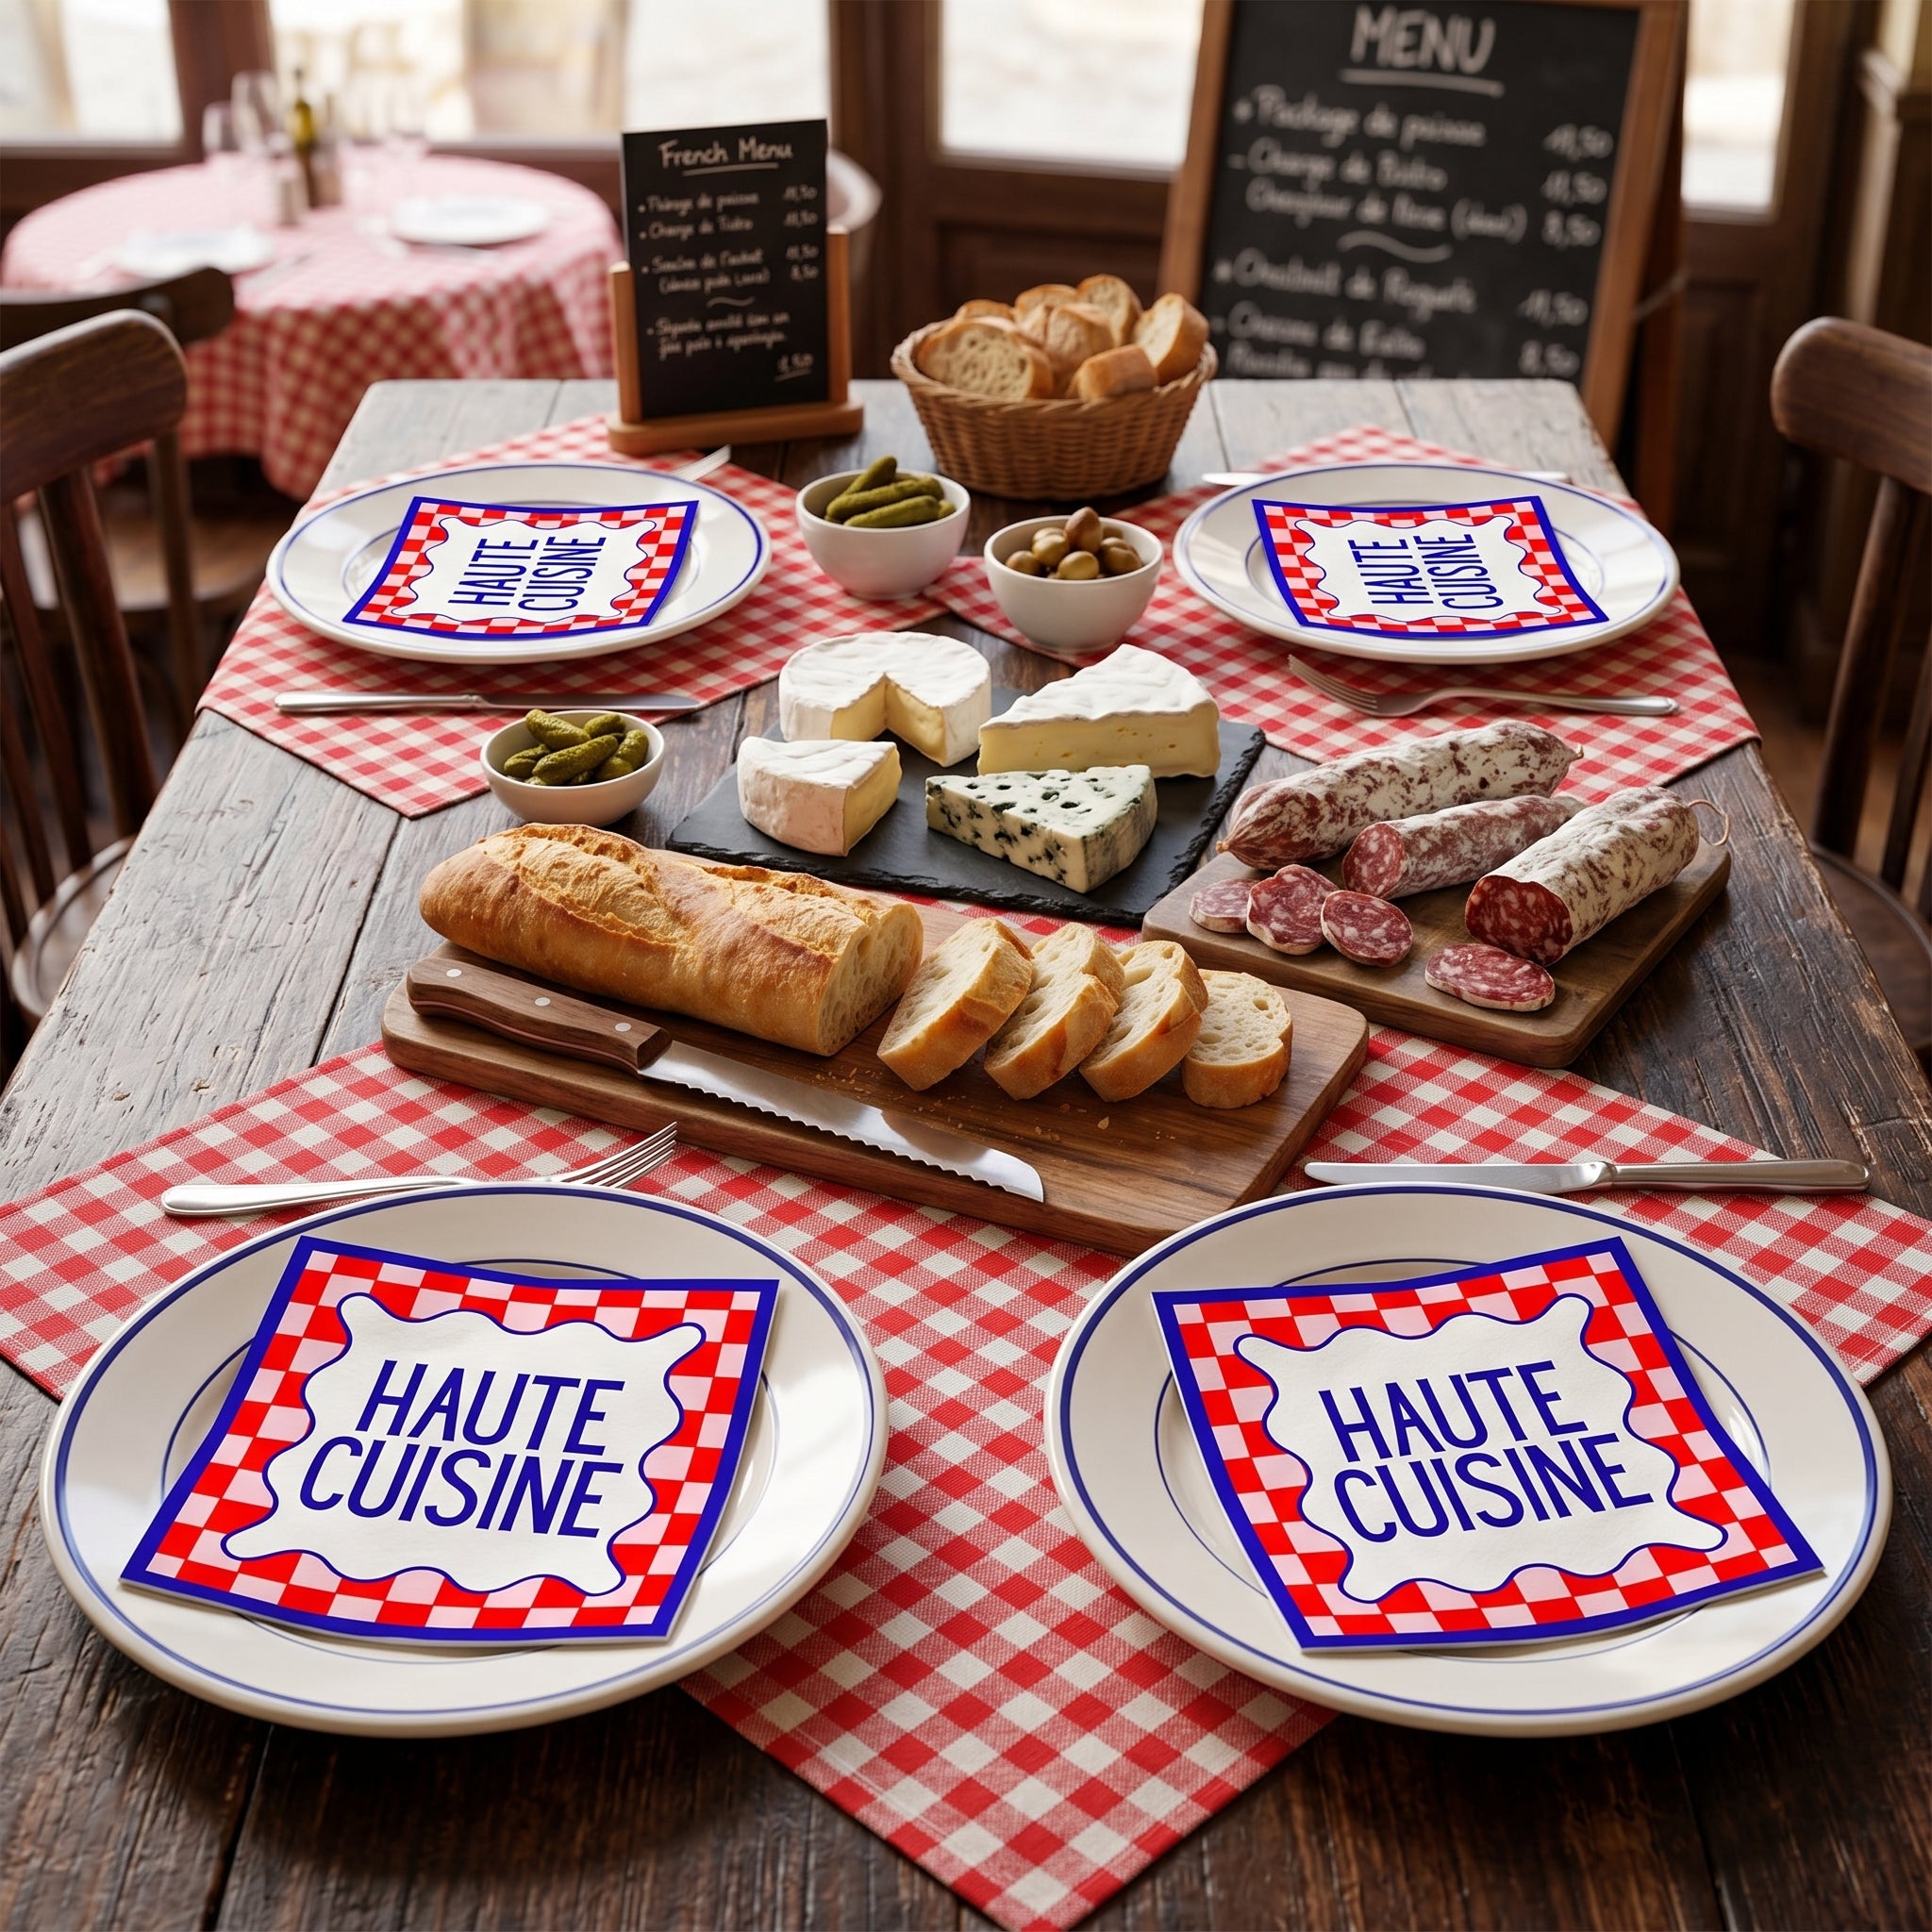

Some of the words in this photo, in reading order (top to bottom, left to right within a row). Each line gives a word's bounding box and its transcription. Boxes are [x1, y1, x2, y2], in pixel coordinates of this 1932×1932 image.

[1351, 4, 1497, 74] MENU
[658, 139, 728, 168] French
[739, 136, 793, 161] Menu
[448, 538, 540, 606] HAUTE
[518, 536, 606, 611] CUISINE
[1348, 539, 1434, 604] HAUTE
[1412, 534, 1504, 609] CUISINE
[356, 1359, 625, 1457] HAUTE
[1318, 1359, 1589, 1463] HAUTE
[300, 1436, 624, 1539] CUISINE
[1333, 1433, 1655, 1543] CUISINE
